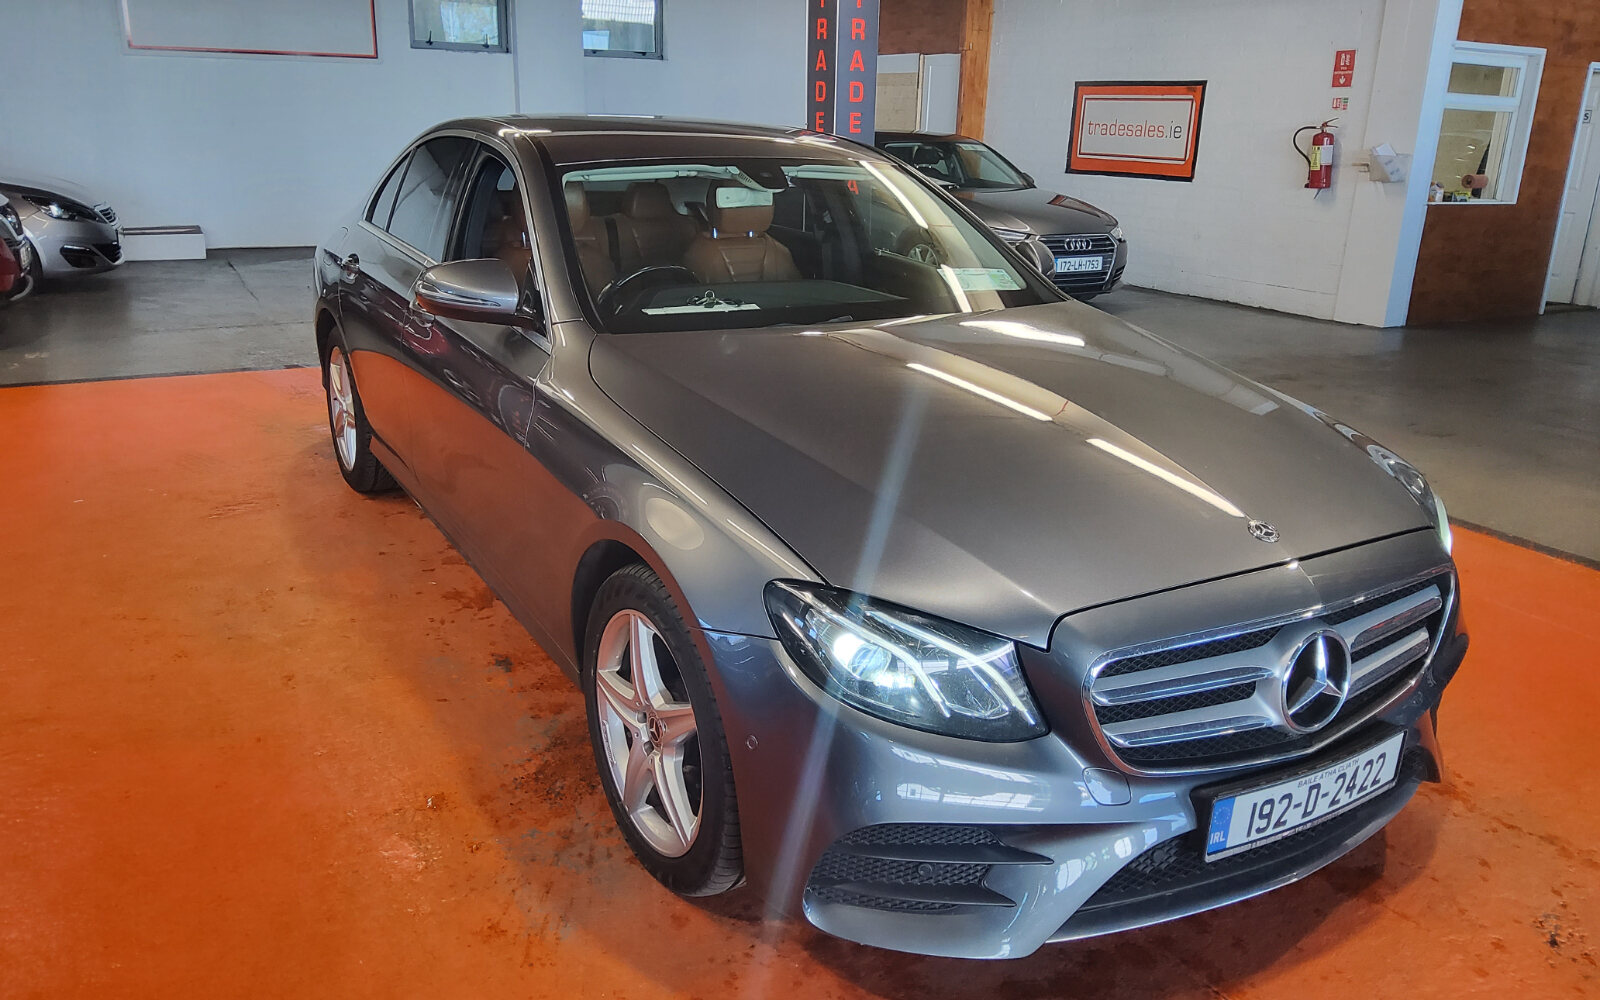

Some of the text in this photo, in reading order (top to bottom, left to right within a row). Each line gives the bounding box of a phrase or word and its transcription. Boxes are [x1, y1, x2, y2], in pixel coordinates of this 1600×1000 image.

[1087, 119, 1183, 139] tradesales.ie
[1060, 260, 1099, 271] 172-LH-1753
[1246, 752, 1387, 838] 192-D-2422
[1209, 830, 1226, 845] IRL
